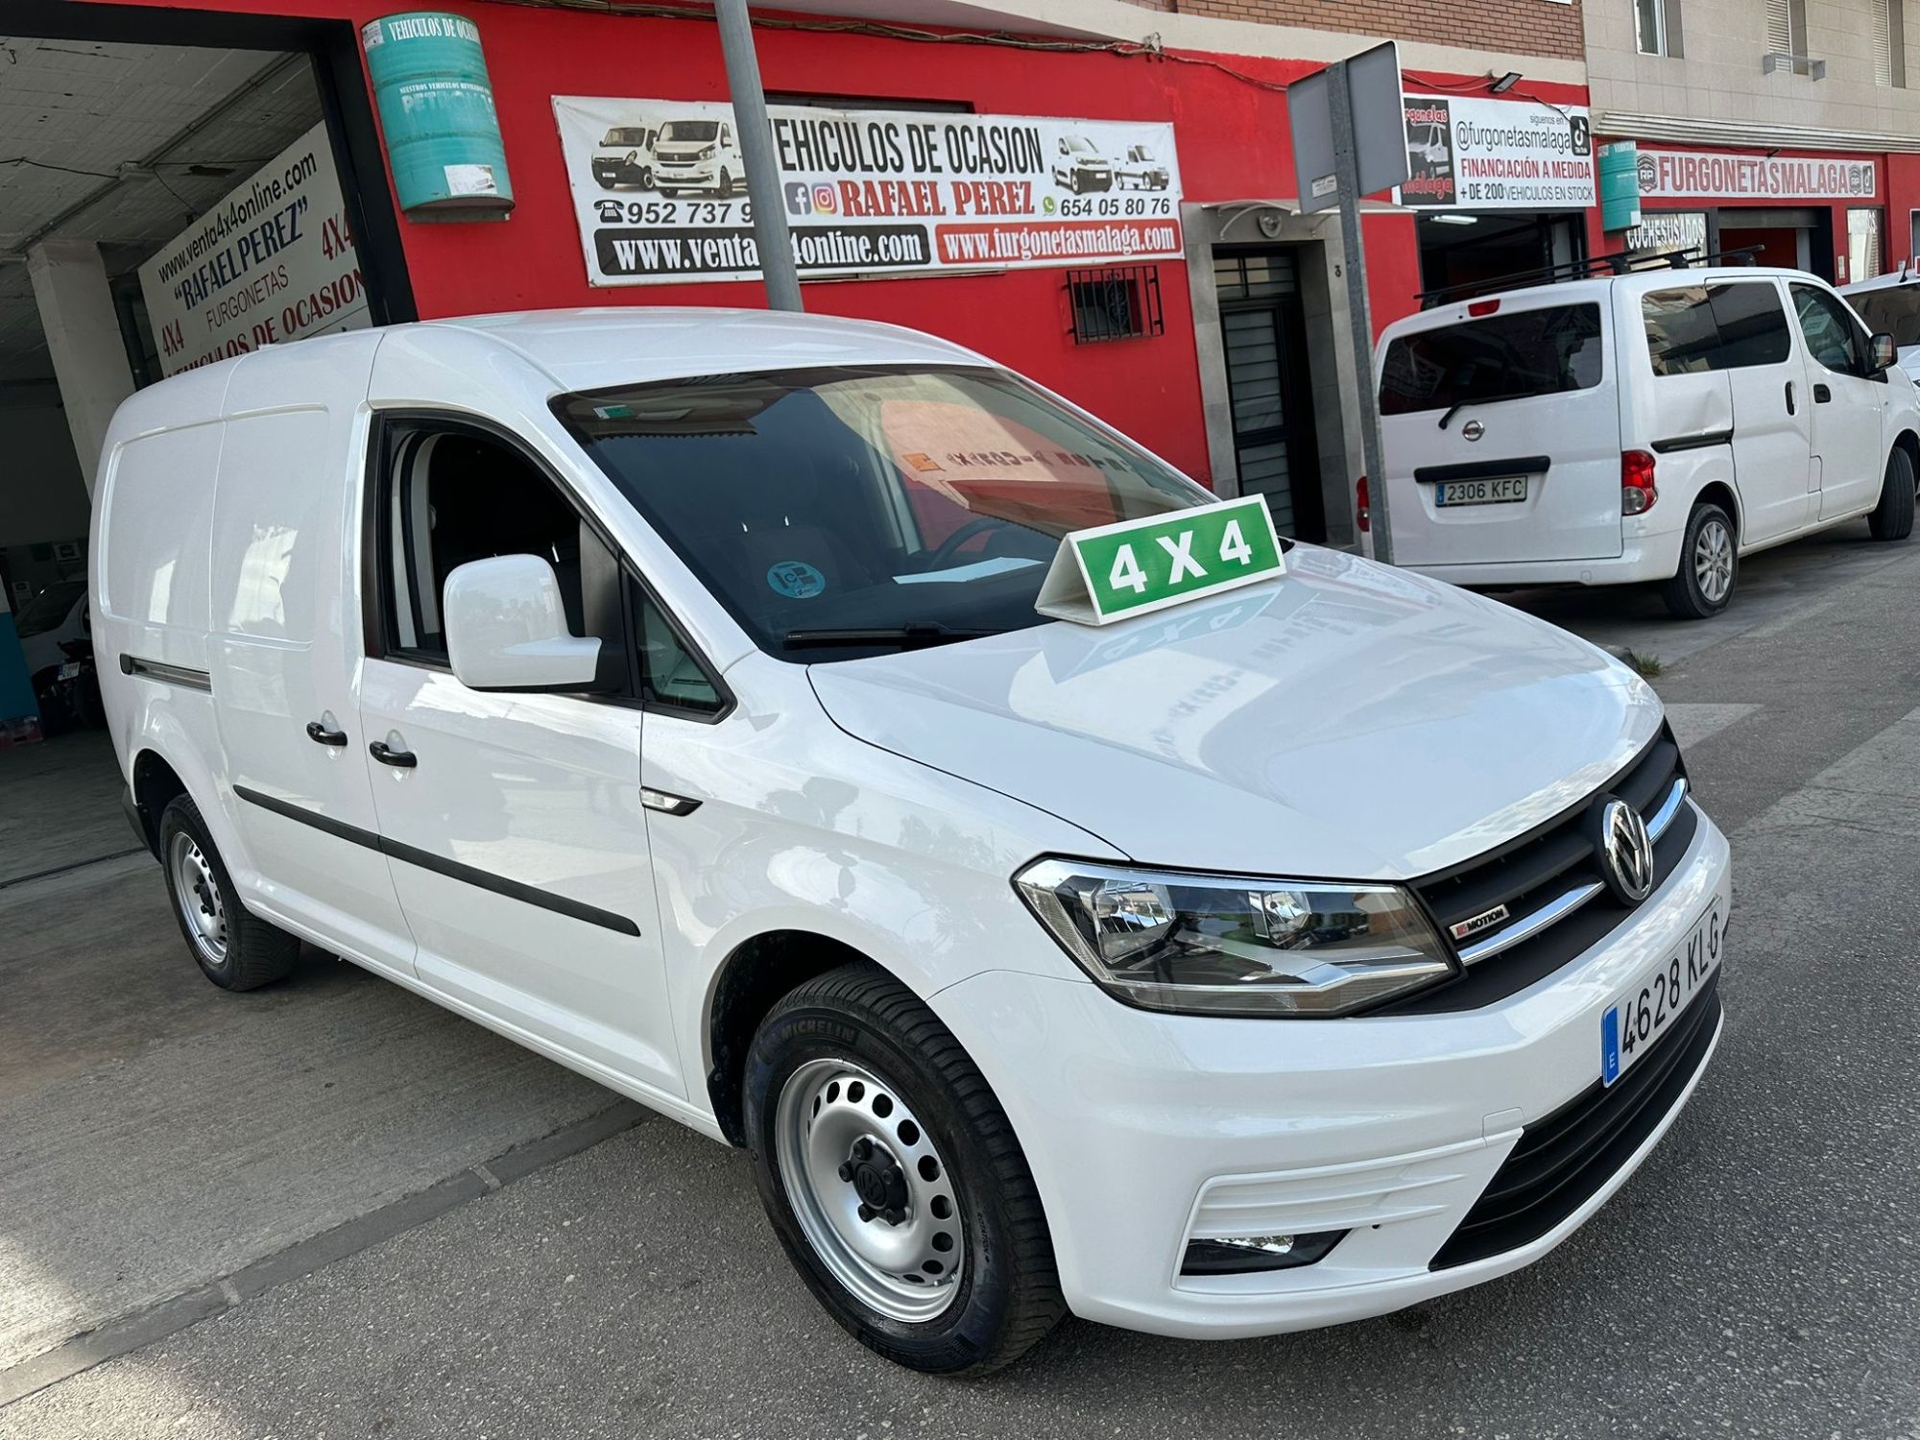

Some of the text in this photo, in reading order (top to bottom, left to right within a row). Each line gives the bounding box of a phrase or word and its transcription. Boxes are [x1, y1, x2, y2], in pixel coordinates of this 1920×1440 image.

[388, 17, 443, 41] VEHICULOS
[442, 18, 457, 38] DE
[1405, 104, 1448, 124] rgonetas
[768, 117, 1045, 174] EHICULOS DE OCASION
[1456, 120, 1571, 155] @furgonetasmalaga
[1461, 156, 1591, 179] FINANCIACIÓN A MEDIDA
[838, 179, 1035, 217] RAFAEL PEREZ
[1060, 197, 1170, 217] 654 05 80 76
[1469, 183, 1482, 200] DE
[1485, 183, 1503, 200] 200
[1504, 185, 1553, 201] VEHICULOS
[1555, 186, 1566, 201] EN
[1567, 187, 1594, 201] STOCK
[158, 152, 317, 284] www.venta4x4online.com
[627, 202, 677, 225] 952
[686, 202, 732, 224] 737
[943, 224, 1176, 260] www.furgonetasmalaga.com
[205, 264, 289, 332] FURGONETAS
[252, 317, 279, 349] DE
[282, 268, 365, 335] OCASION
[161, 319, 185, 358] 4X4
[1447, 480, 1522, 501] 2306 KFC
[1109, 519, 1252, 593] 4 X 4
[1622, 911, 1719, 1055] 4628 KLG
[781, 1020, 855, 1042] MICHELIN
[1609, 1053, 1616, 1069] E
